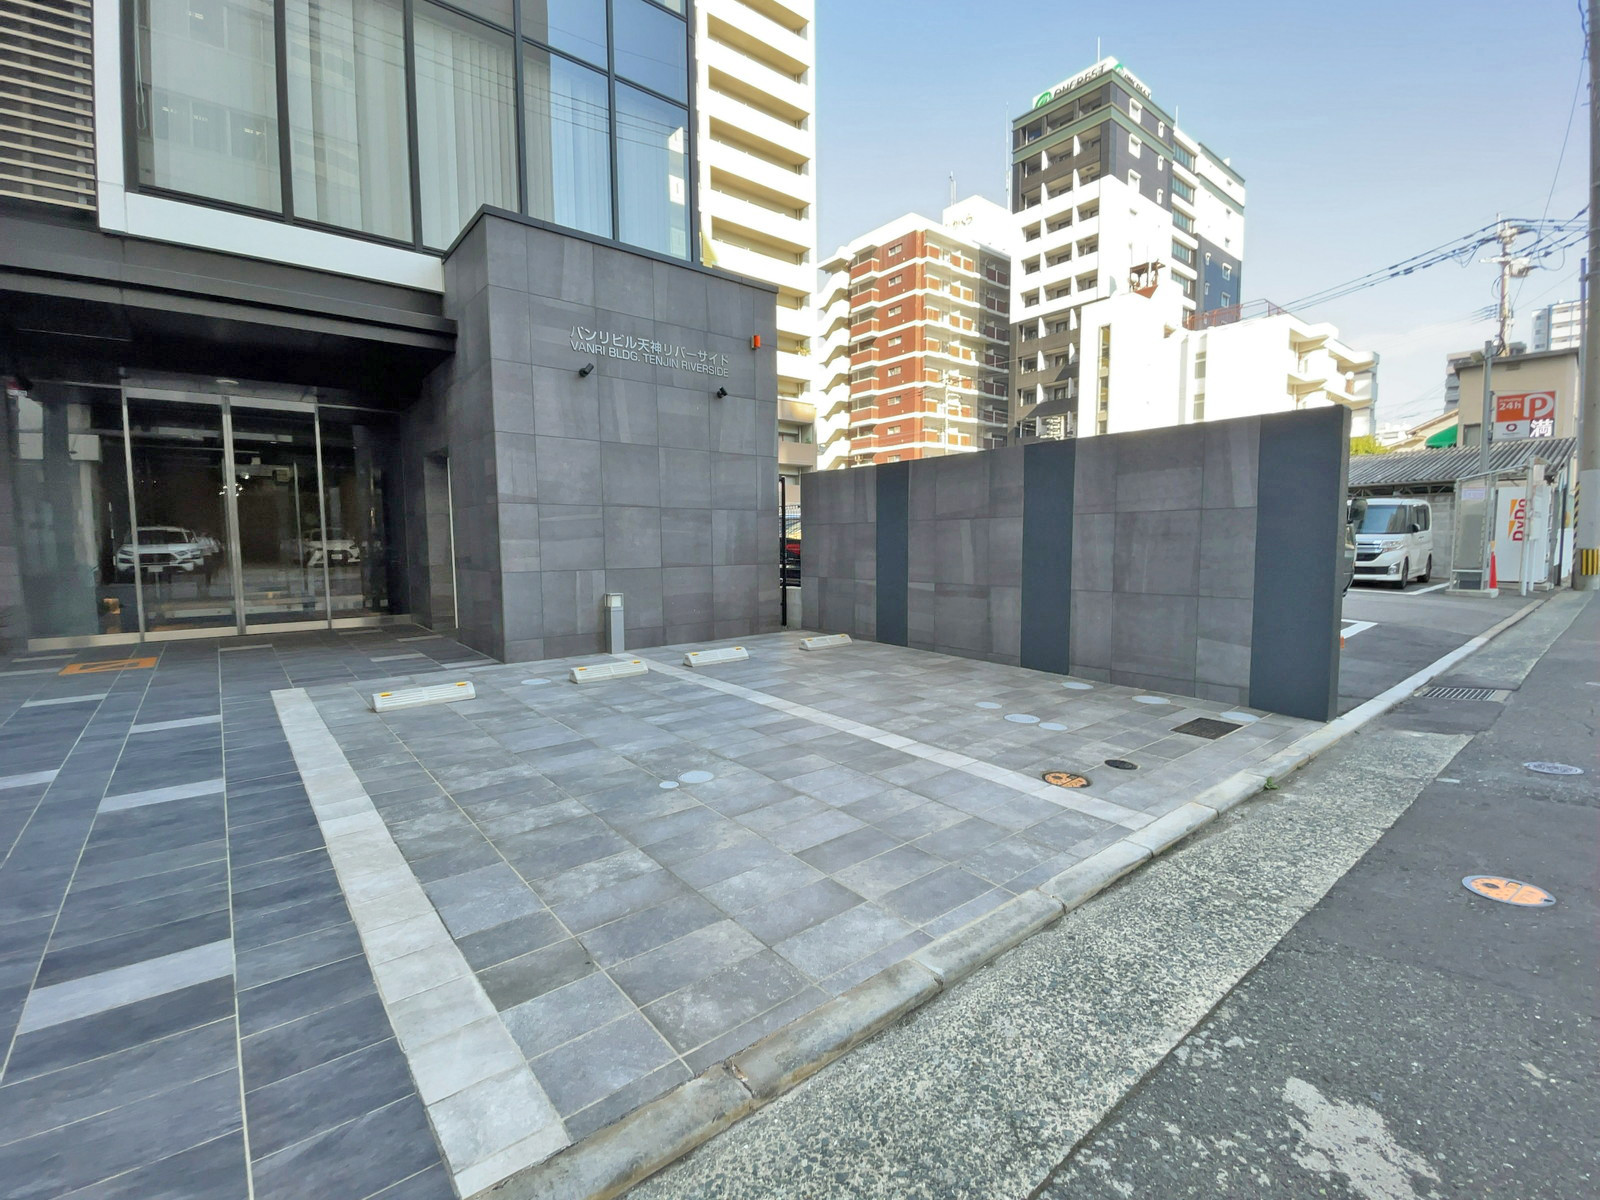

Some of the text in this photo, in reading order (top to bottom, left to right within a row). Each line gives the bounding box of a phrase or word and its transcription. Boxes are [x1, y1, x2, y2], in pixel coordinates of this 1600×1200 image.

[570, 325, 729, 366] バンリビル天神リバーサイド
[570, 339, 729, 378] VANRI BLDG. TENJIN RIVERSIDE
[1499, 401, 1522, 411] 24h
[1523, 392, 1554, 418] P
[1529, 418, 1554, 438] 満
